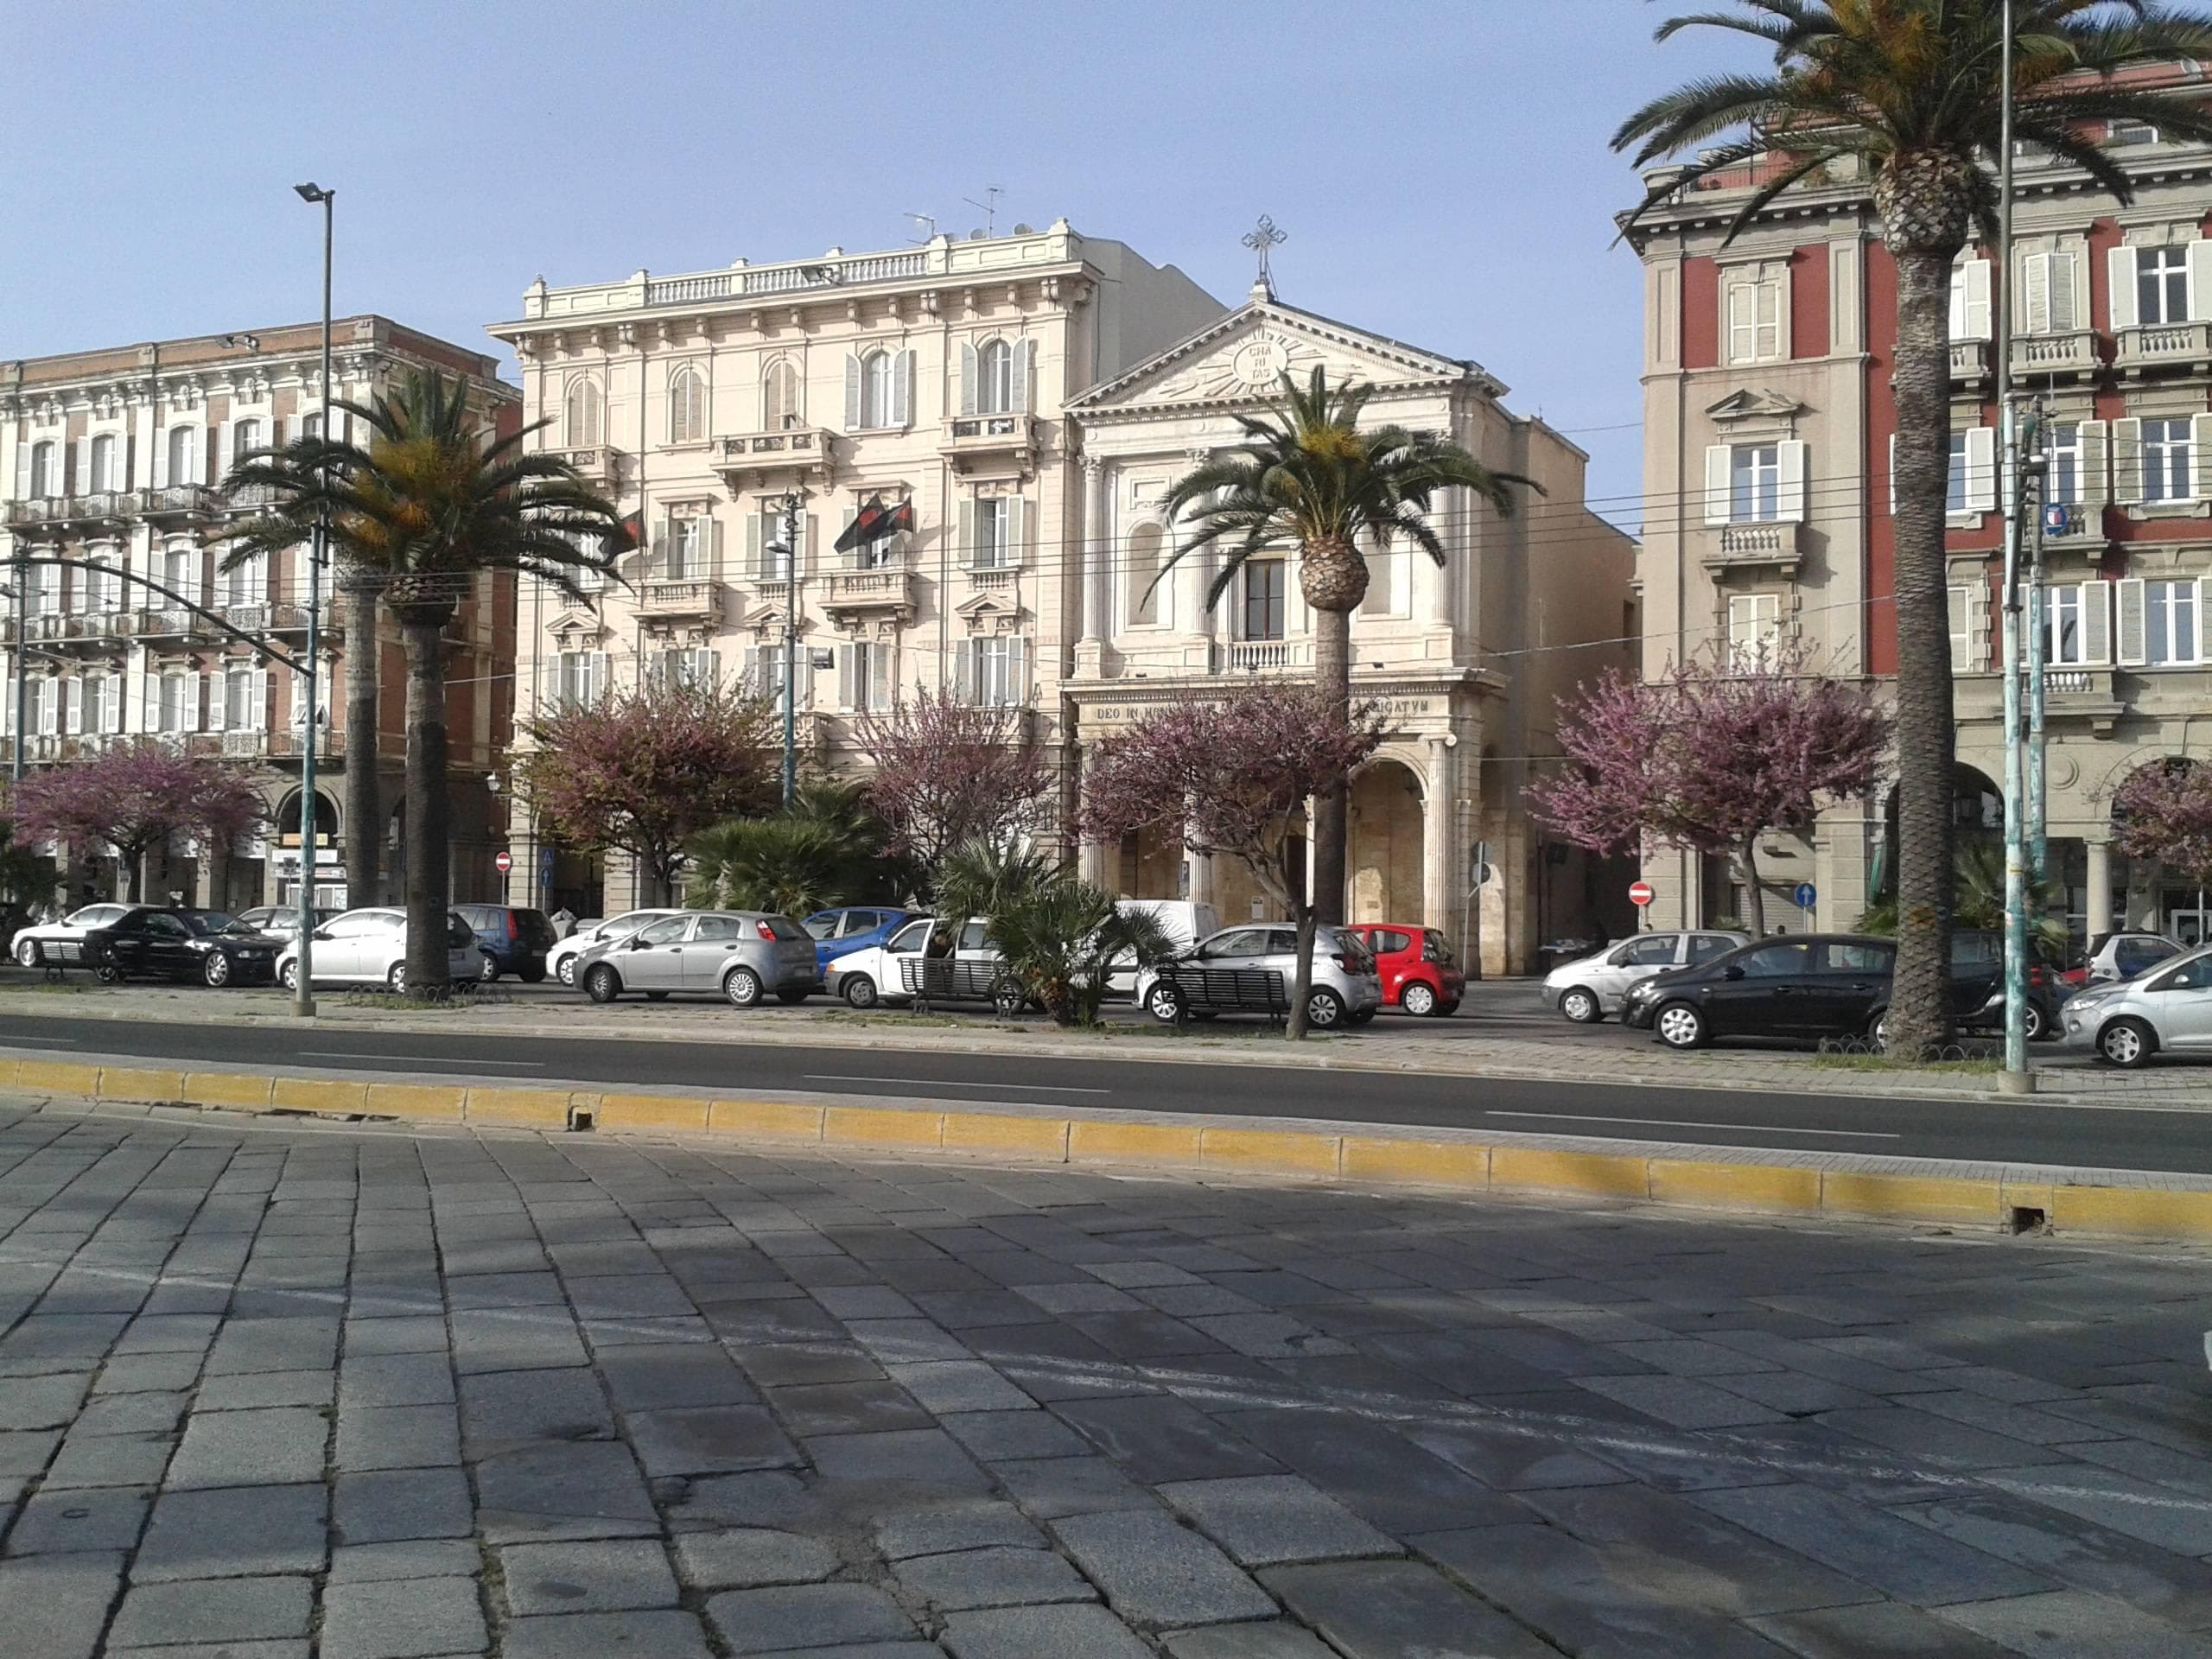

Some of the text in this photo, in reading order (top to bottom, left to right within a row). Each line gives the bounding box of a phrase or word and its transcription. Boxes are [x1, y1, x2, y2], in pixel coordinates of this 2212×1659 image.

[1249, 346, 1271, 357] CHA
[1097, 708, 1120, 719] DEO
[1126, 707, 1139, 719] IN
